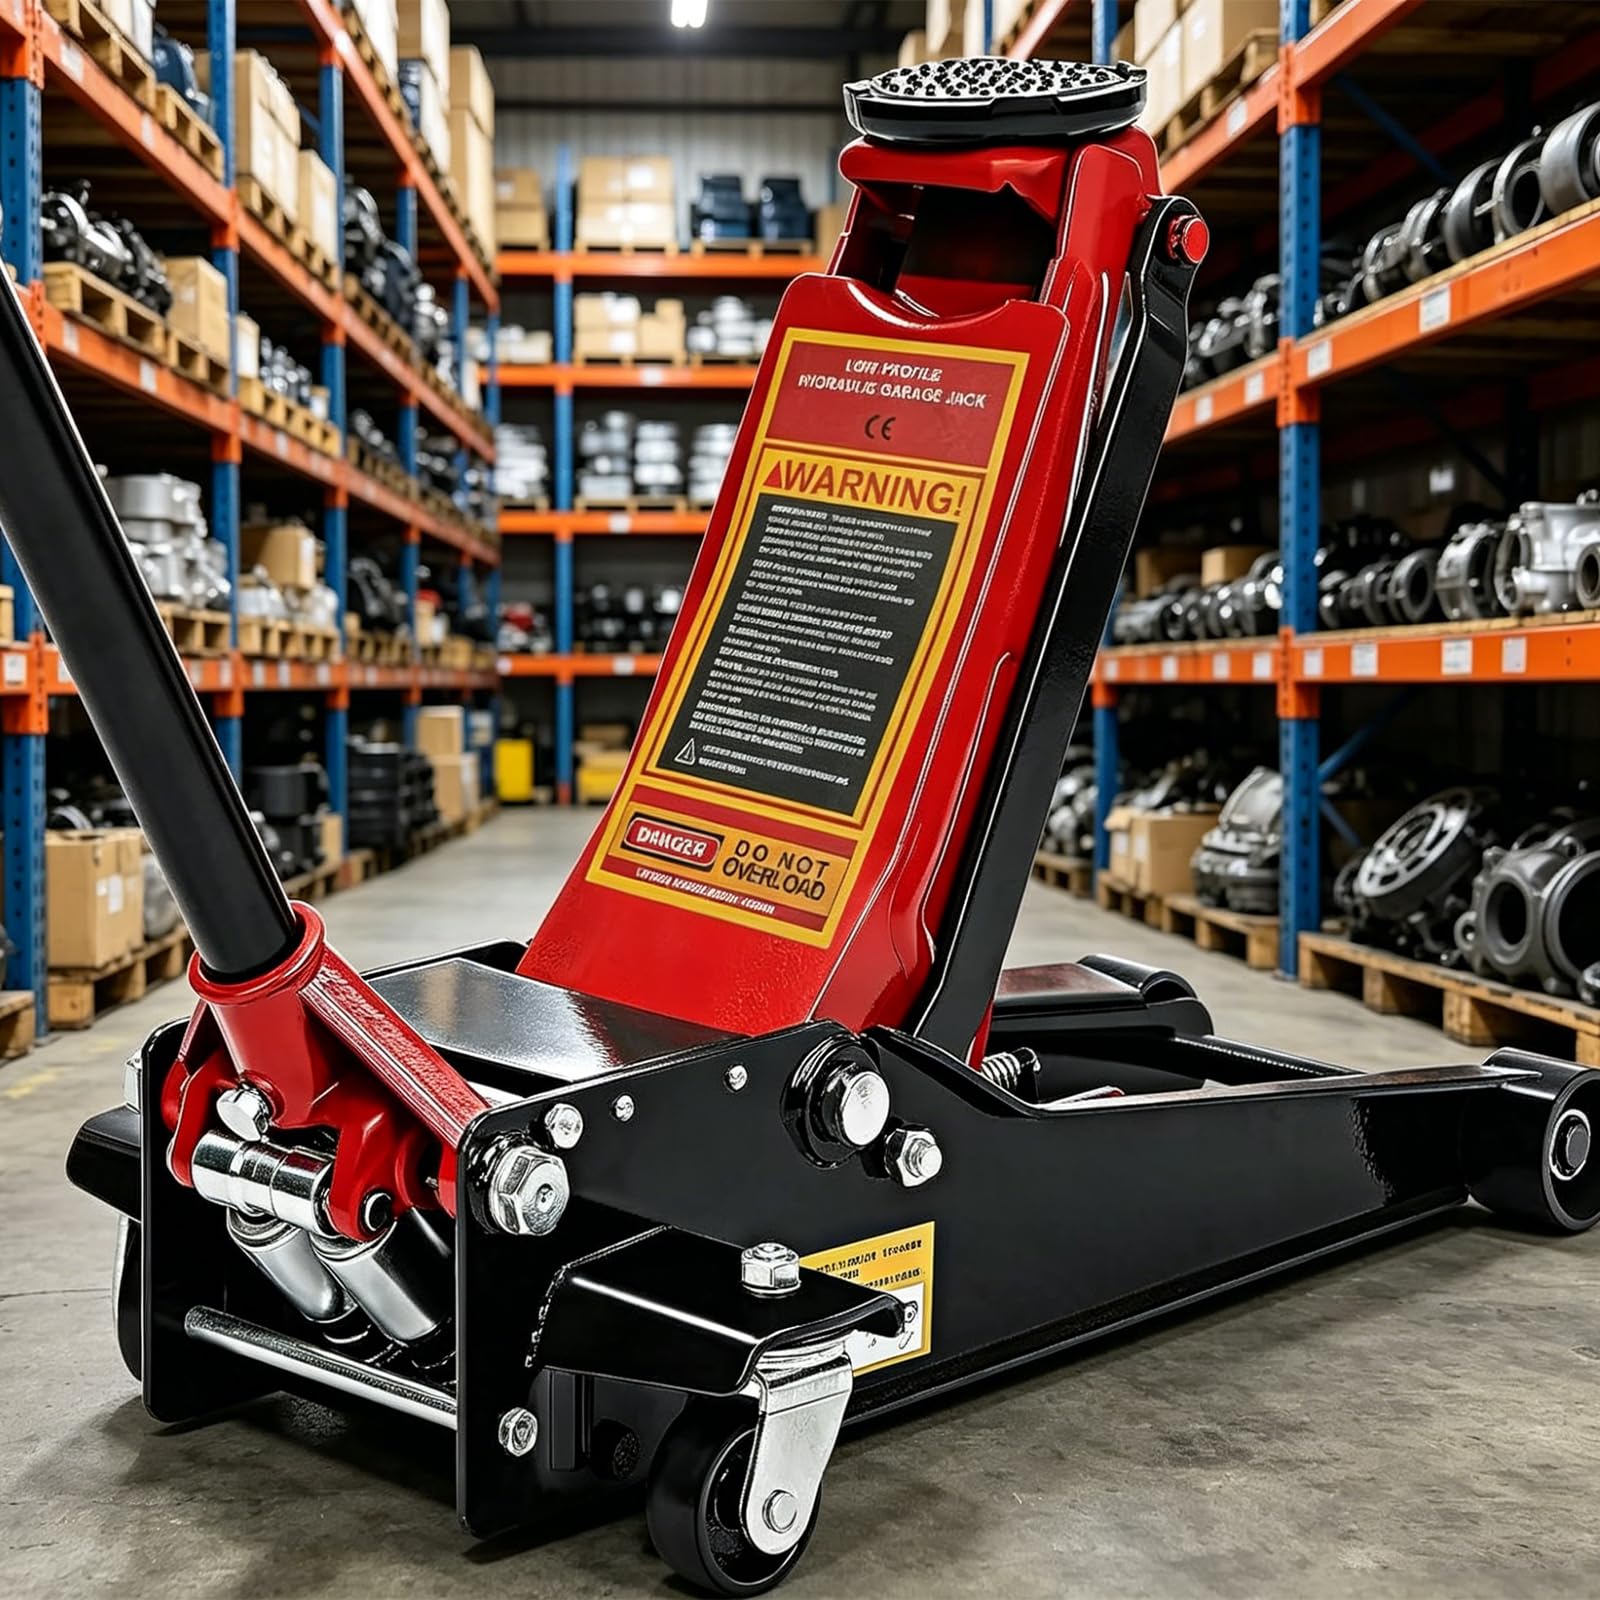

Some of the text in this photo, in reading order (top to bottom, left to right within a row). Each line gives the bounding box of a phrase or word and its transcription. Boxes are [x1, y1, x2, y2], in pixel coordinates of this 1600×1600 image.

[880, 383, 943, 403] GARAGE
[784, 459, 968, 516] WARNING!
[722, 857, 826, 901] OVERLOAD
[734, 840, 830, 879] DO NOT
